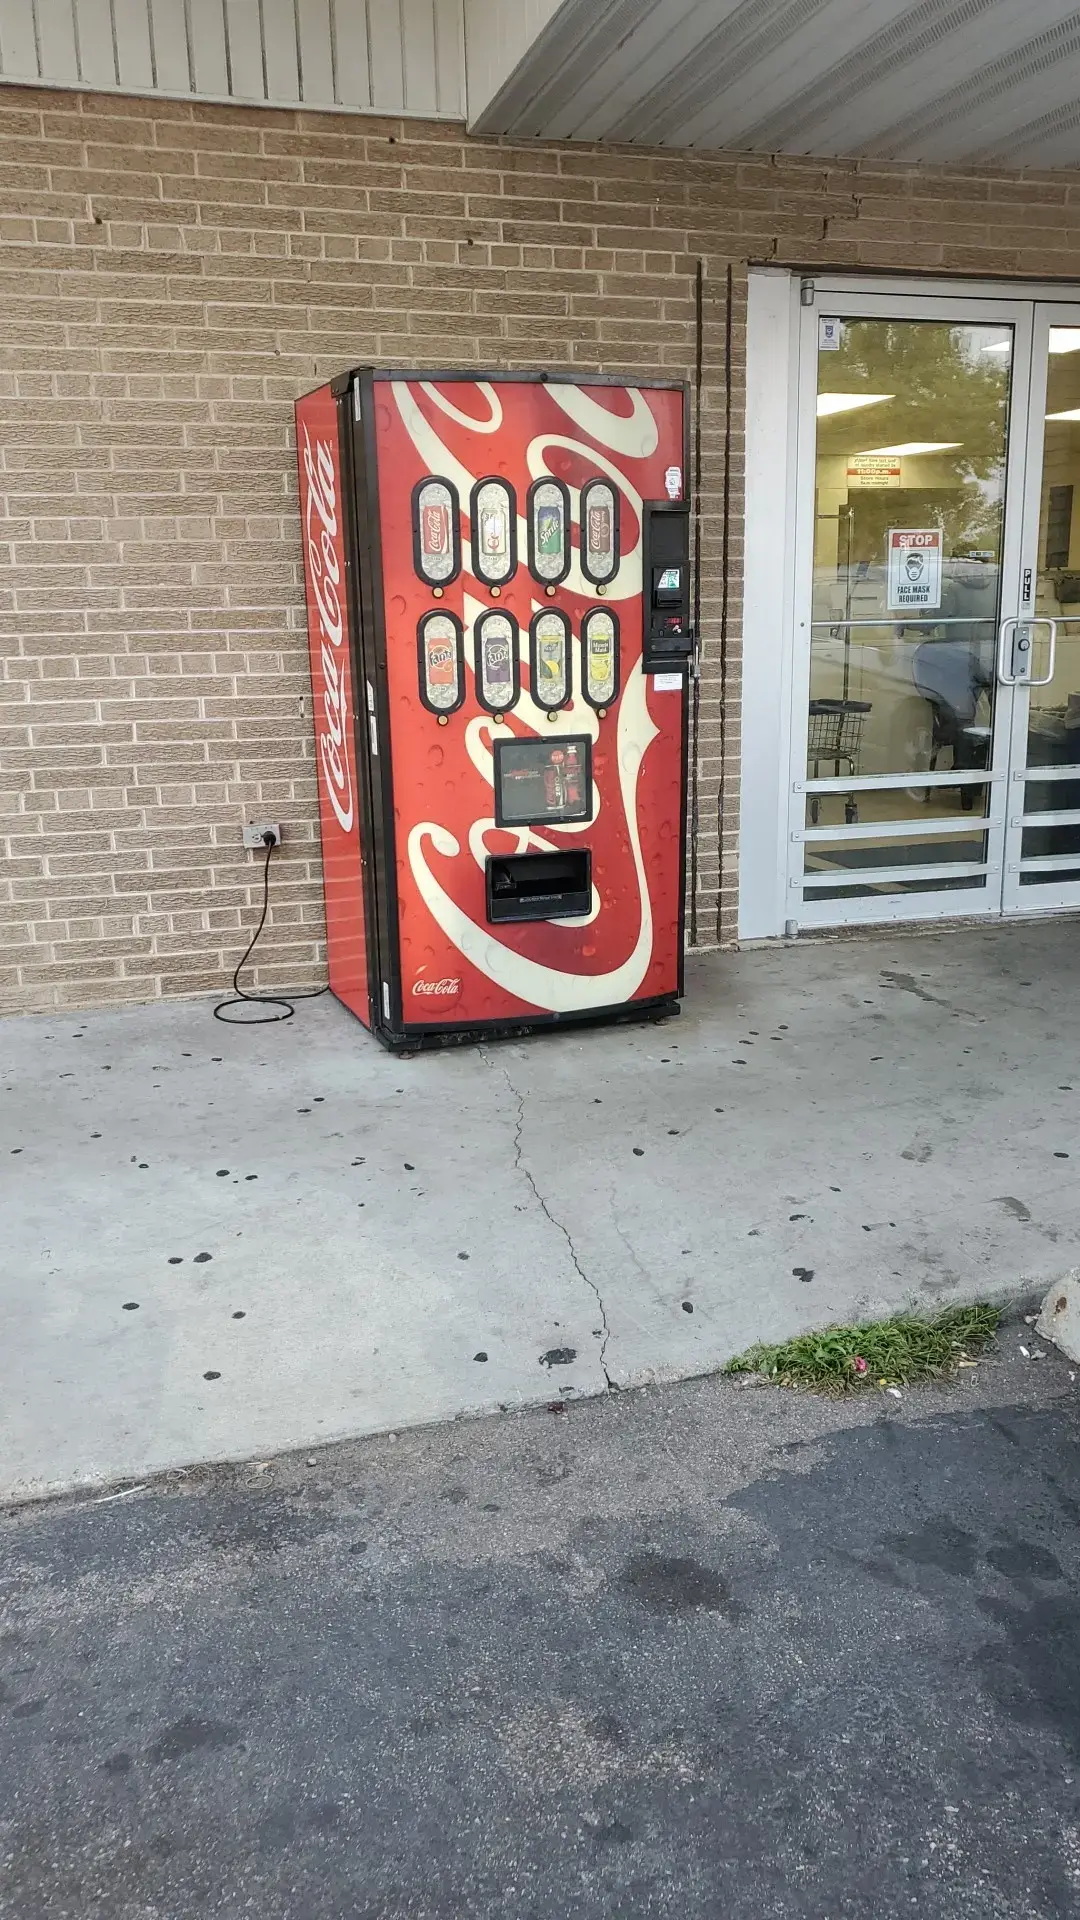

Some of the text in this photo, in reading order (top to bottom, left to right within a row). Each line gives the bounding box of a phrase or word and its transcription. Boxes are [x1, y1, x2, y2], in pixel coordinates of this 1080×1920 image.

[540, 519, 560, 546] Sprite
[899, 535, 933, 546] STOP
[897, 585, 931, 594] FACE MASK
[898, 594, 928, 603] REQUIRED
[302, 420, 353, 832] Coca-Cola
[412, 978, 460, 996] Coca-Cola
